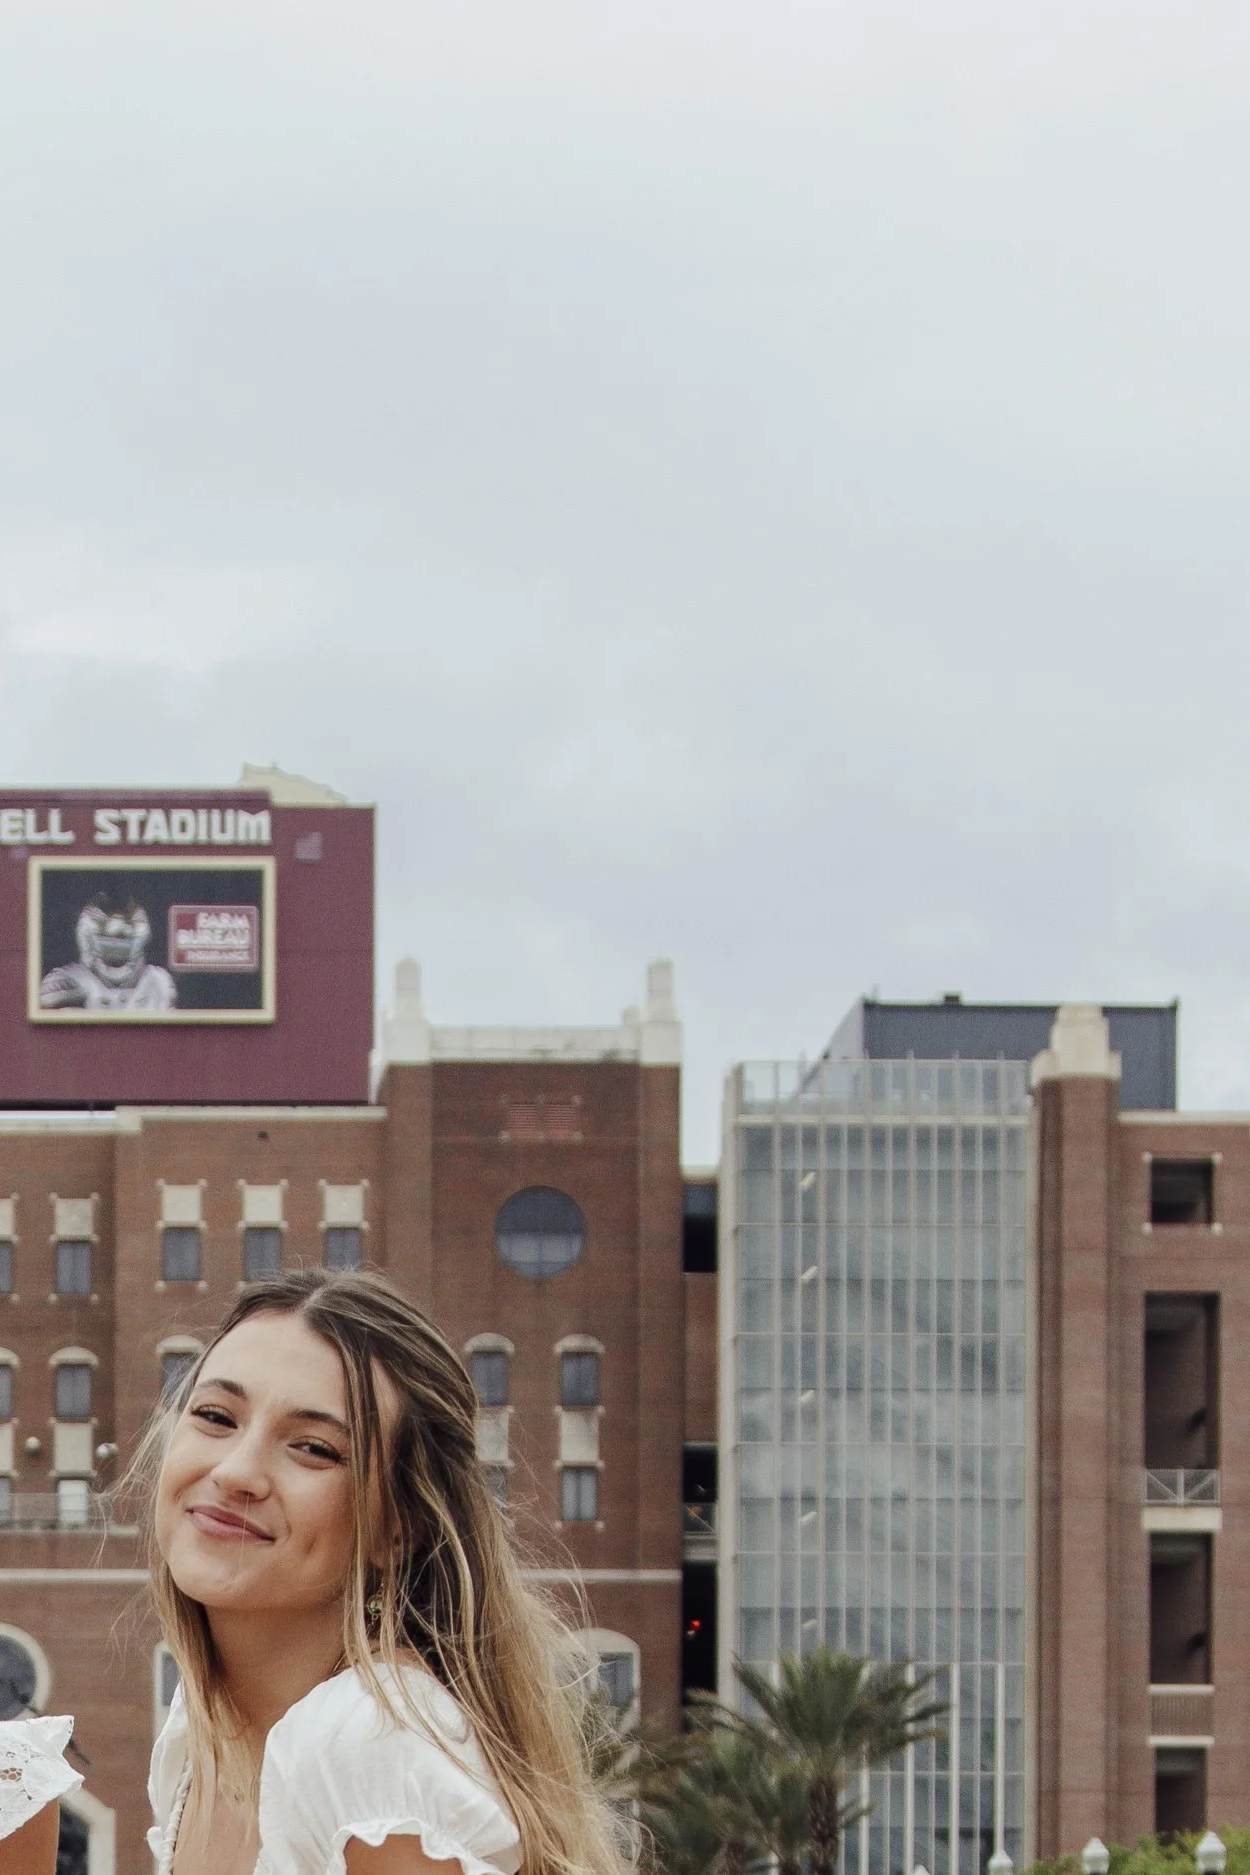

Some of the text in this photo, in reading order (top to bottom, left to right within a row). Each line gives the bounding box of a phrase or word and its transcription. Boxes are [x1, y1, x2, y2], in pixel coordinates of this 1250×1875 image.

[93, 807, 272, 845] STADIUM
[197, 912, 249, 929] FARM
[176, 929, 249, 946] BUREAU
